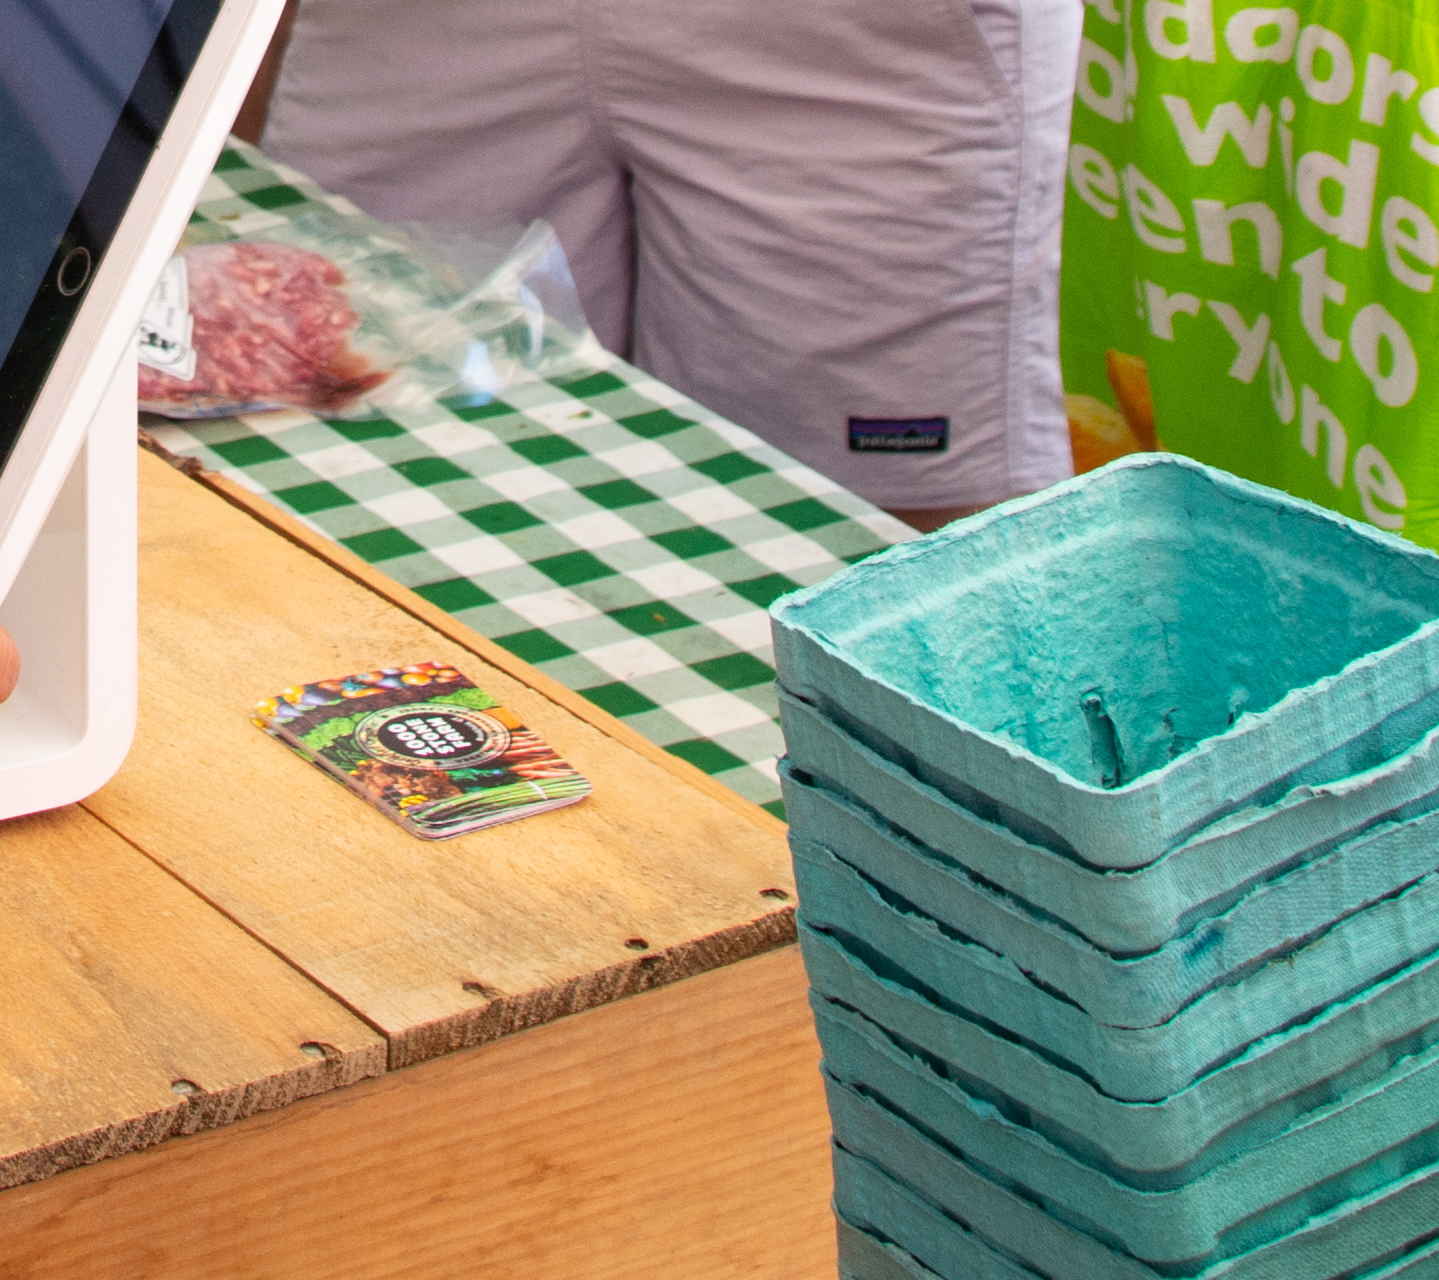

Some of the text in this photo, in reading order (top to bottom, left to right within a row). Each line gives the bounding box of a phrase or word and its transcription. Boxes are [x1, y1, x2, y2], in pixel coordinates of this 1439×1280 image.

[1290, 245, 1420, 409] to
[1132, 273, 1409, 531] ryone
[387, 722, 435, 757] 1000
[404, 717, 456, 755] STONE
[426, 716, 472, 749] FARM
